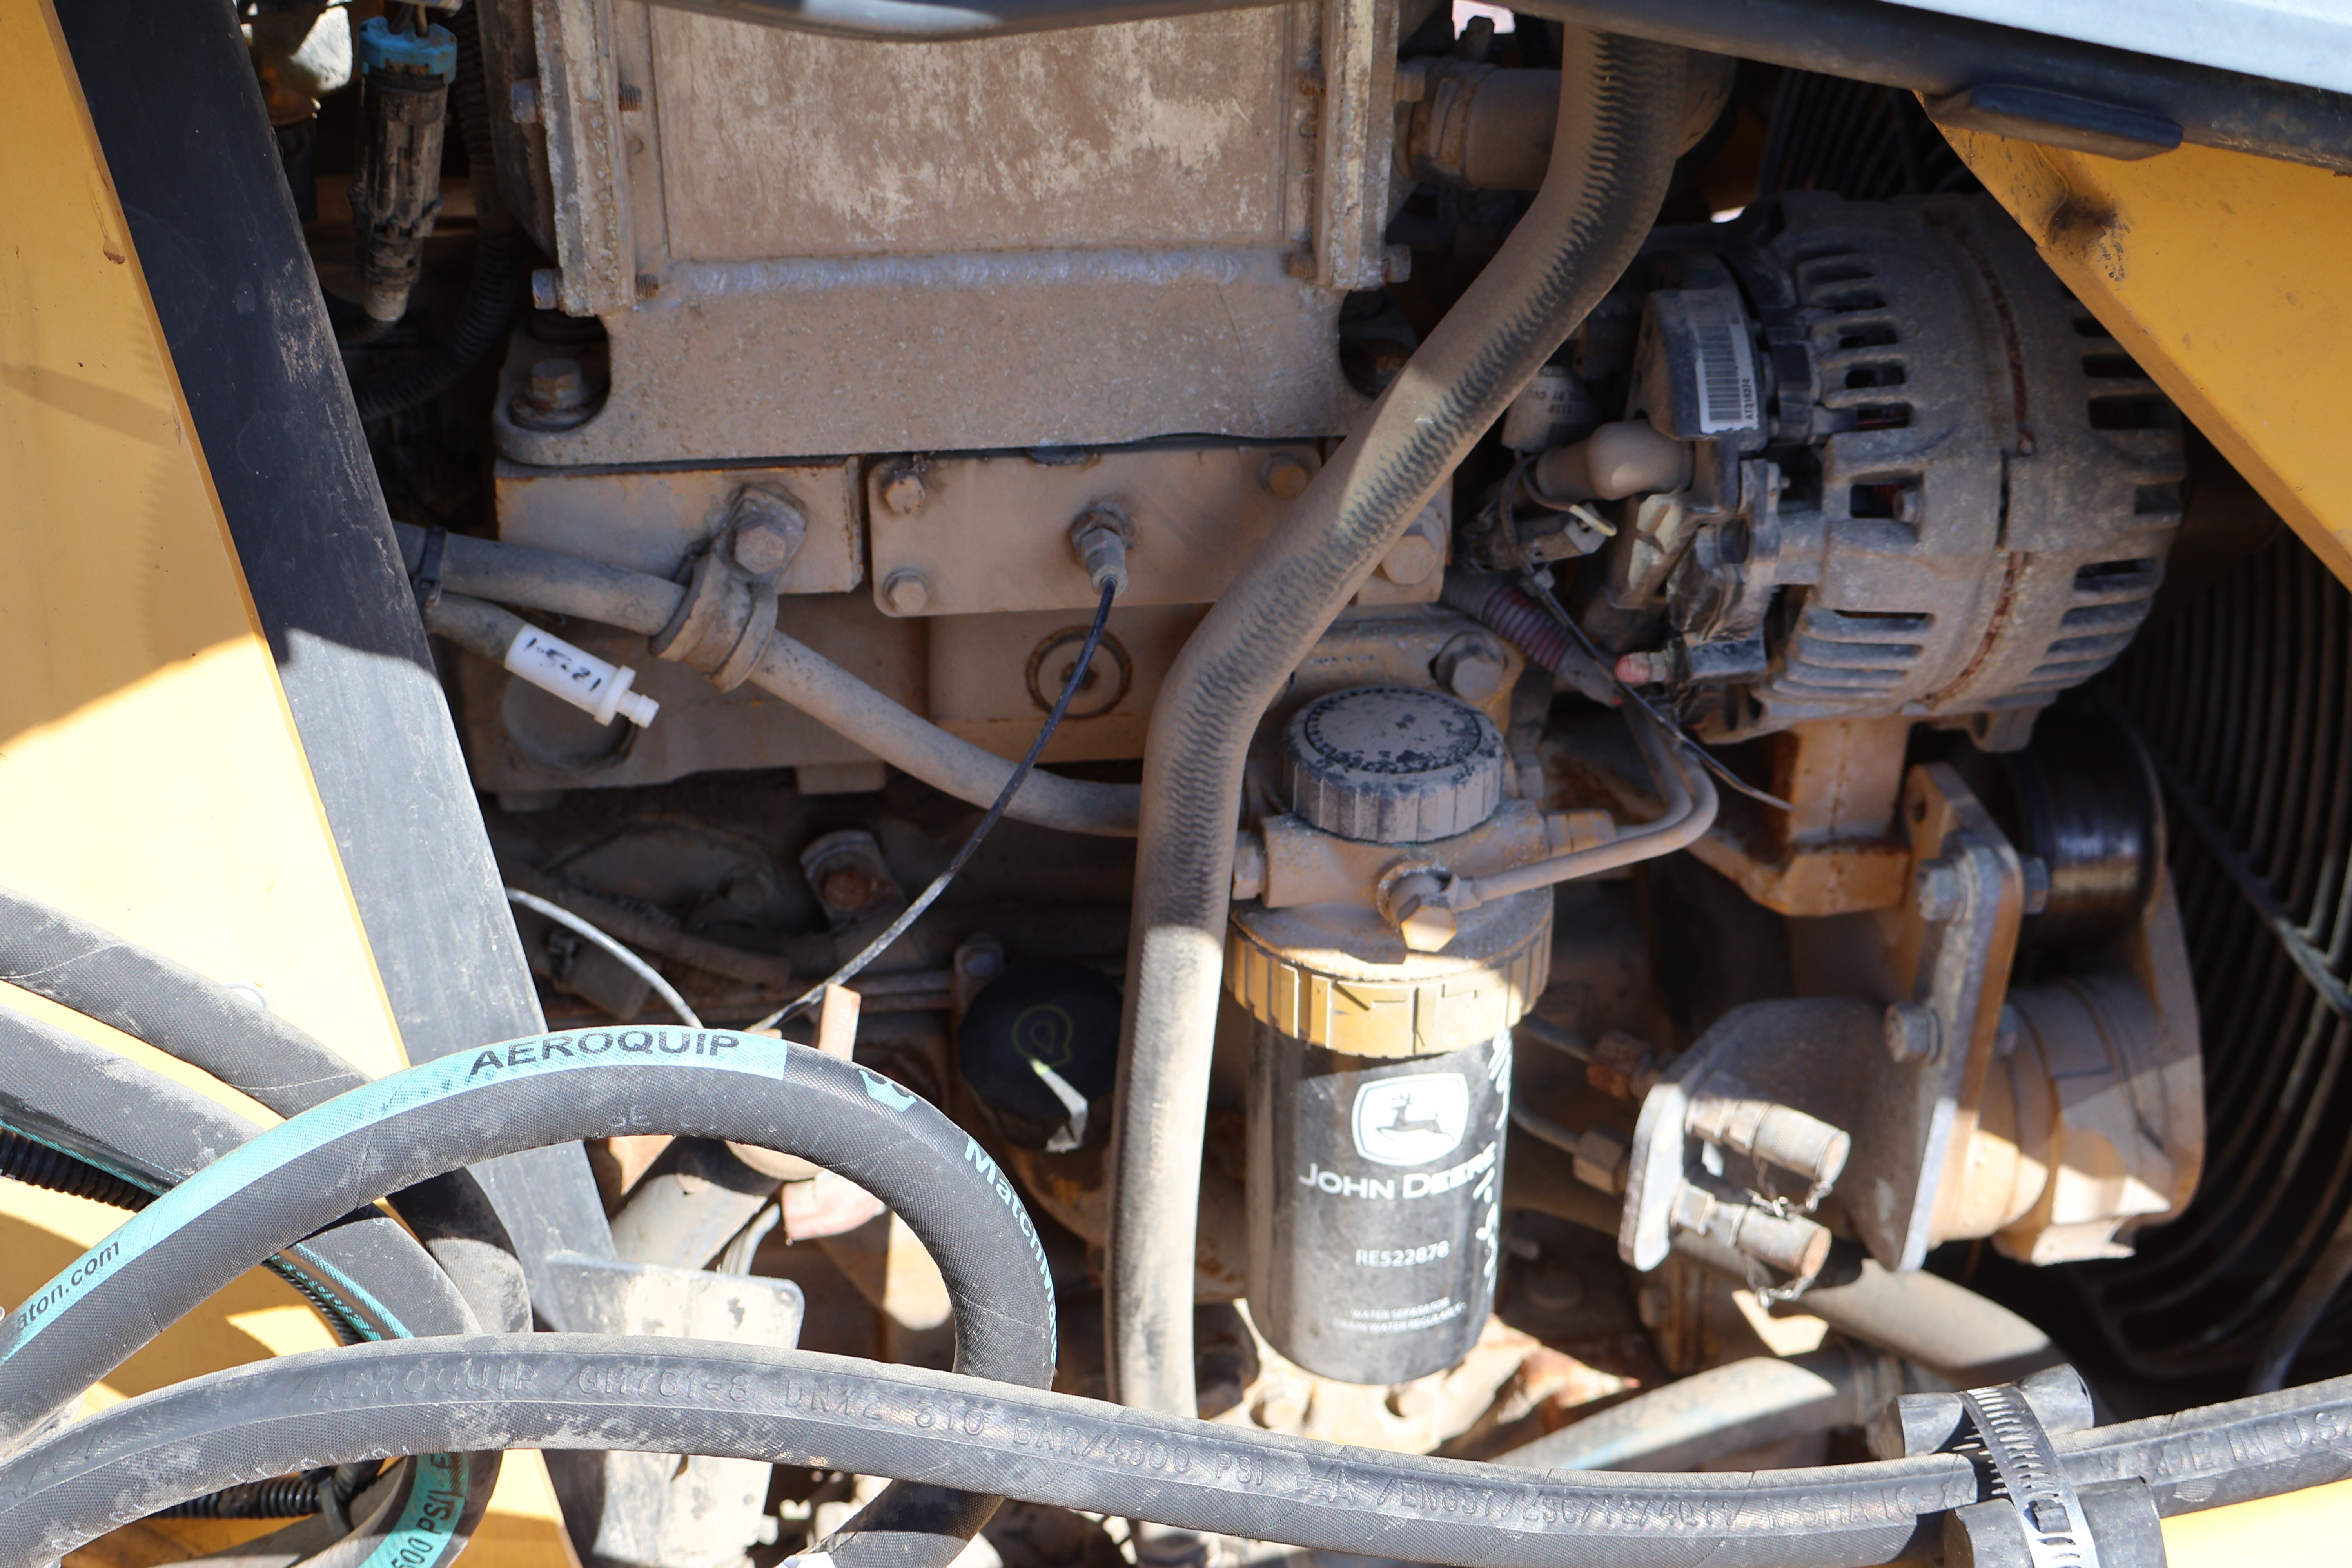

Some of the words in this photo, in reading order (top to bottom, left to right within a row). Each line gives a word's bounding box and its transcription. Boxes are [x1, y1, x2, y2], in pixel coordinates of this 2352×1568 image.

[470, 1031, 739, 1075] AEROQUIP
[1299, 1163, 1395, 1200] JOHN
[1403, 1141, 1497, 1199] DEERE
[1356, 1240, 1450, 1267] RE522878
[16, 1241, 119, 1330] aton.com
[312, 1363, 535, 1403] AEROQUIP
[784, 1377, 884, 1421] DN12
[915, 1400, 985, 1436] 310
[1013, 1417, 1193, 1474] BAR/4500
[1214, 1452, 1263, 1486] PSI
